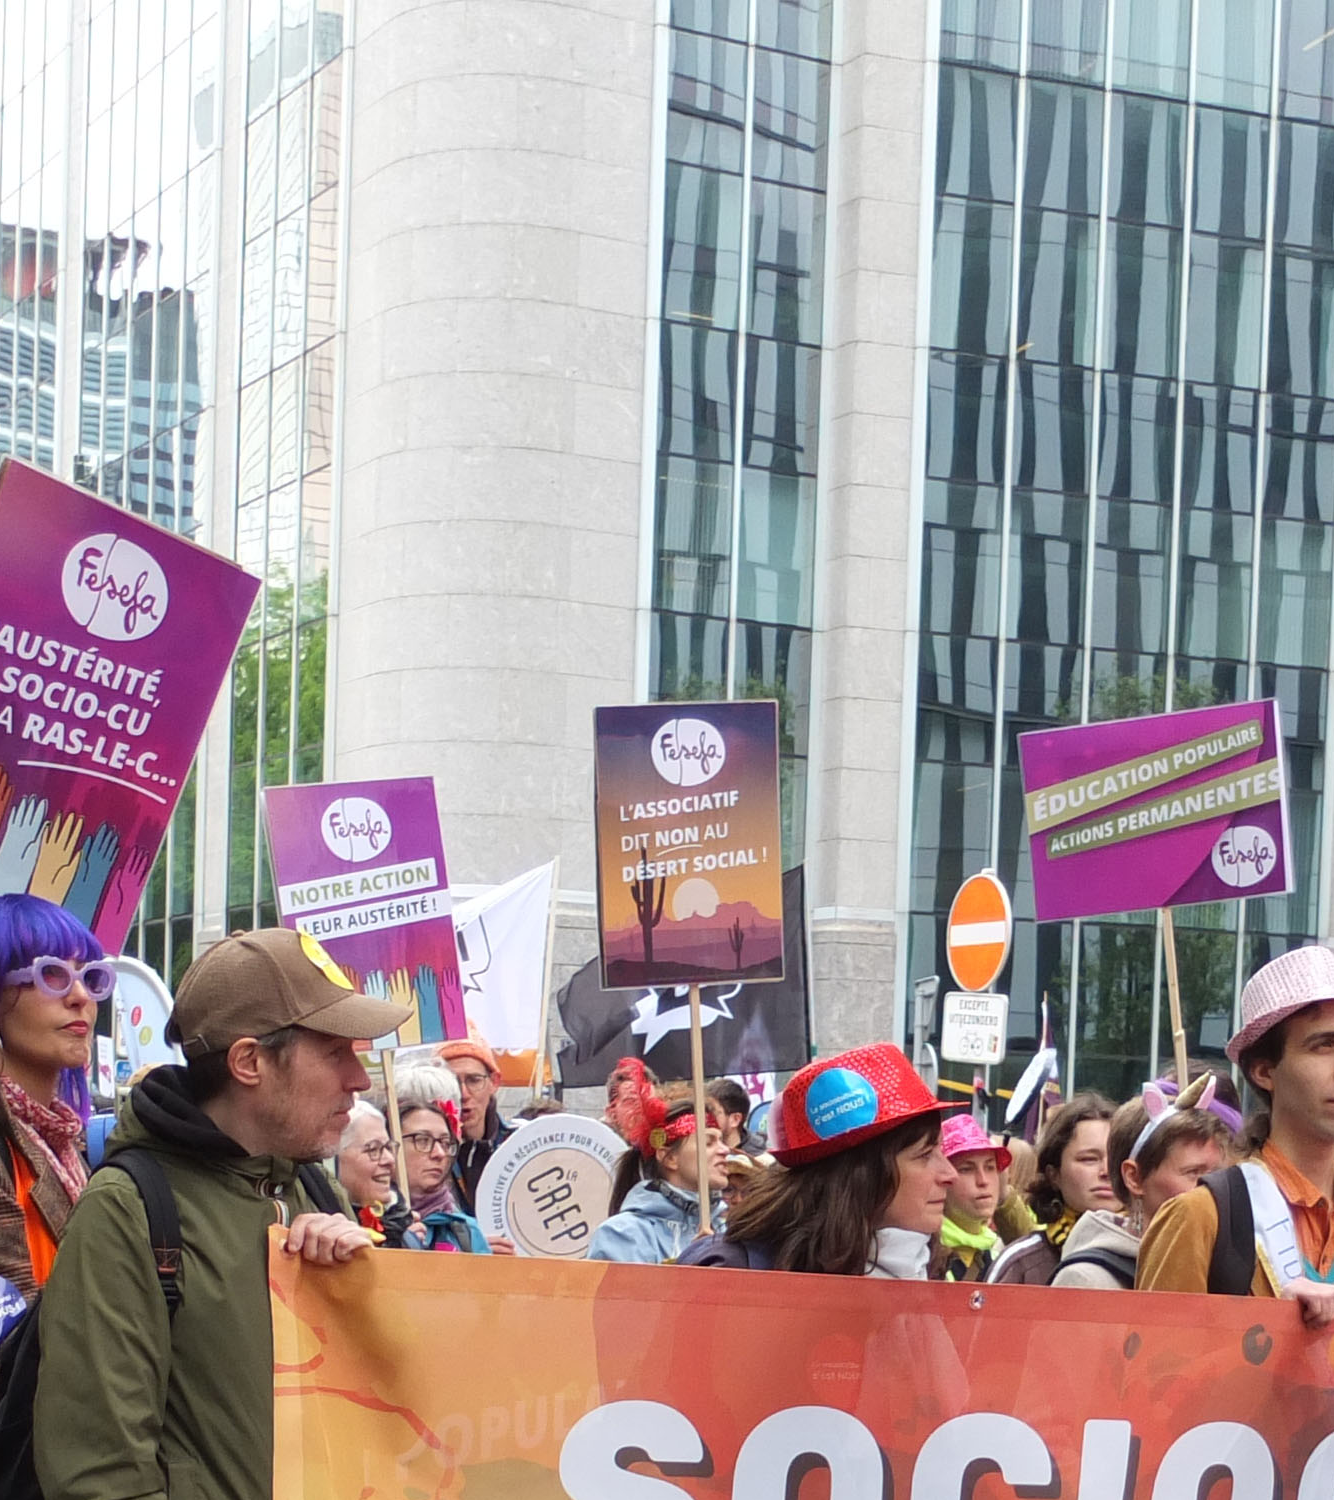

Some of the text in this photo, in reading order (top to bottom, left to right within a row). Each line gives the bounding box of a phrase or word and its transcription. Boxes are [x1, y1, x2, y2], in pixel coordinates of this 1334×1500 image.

[77, 546, 159, 635] Fesefa
[21, 712, 177, 787] RAS-LE-C...
[1033, 725, 1259, 822] ÉDUCATION POPULAIRE
[619, 789, 740, 822] L'ASSOCIATIF
[1050, 769, 1282, 853] ACTIONS PERMANENTES
[620, 822, 729, 852] DIT NON AU
[290, 864, 431, 907] NOTRE ACTION
[622, 858, 689, 884] DÉSERT
[693, 848, 759, 873] SOCIAL
[303, 917, 344, 937] LEUR
[347, 896, 430, 929] AUSTÉRITÉ
[568, 1132, 593, 1147] POUR
